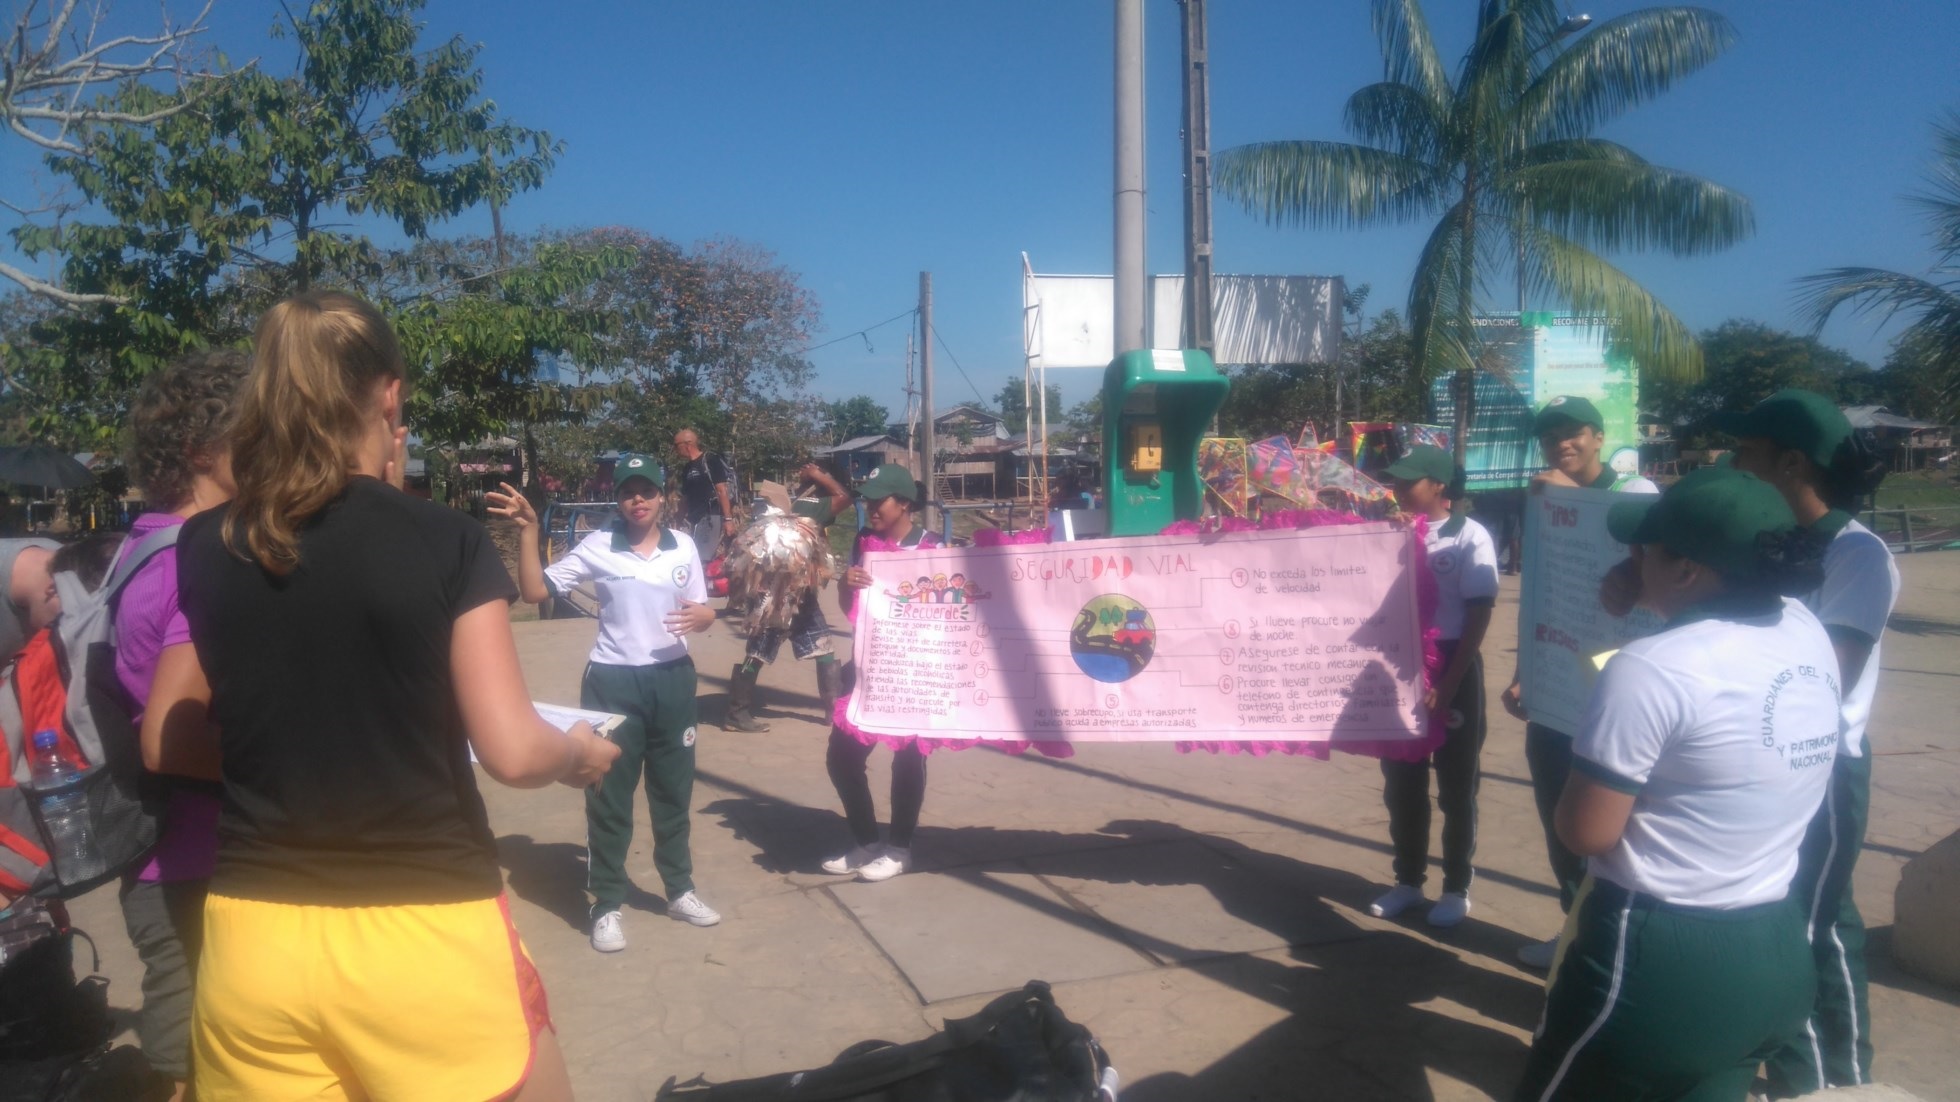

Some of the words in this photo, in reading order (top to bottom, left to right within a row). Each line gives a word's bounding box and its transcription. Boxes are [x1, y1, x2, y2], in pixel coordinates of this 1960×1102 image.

[1011, 555, 1134, 591] SEGURIDAD
[1147, 553, 1199, 576] VIAL
[1252, 569, 1266, 580] No
[1270, 568, 1307, 580] exceda
[1311, 566, 1326, 577] los
[1254, 582, 1269, 594] de
[1275, 582, 1321, 594] velocidad
[902, 603, 960, 620] Recuerde
[944, 624, 970, 633] estado
[1249, 616, 1258, 629] Si
[1265, 616, 1296, 627] llueve
[1301, 616, 1339, 628] procure
[1343, 616, 1356, 626] no
[871, 626, 881, 634] de
[886, 627, 897, 636] las
[1249, 630, 1262, 641] de
[1266, 630, 1294, 641] noche
[921, 638, 930, 646] de
[908, 646, 951, 655] documentos
[1238, 646, 1300, 662] Asegurese
[1305, 643, 1320, 655] de
[866, 666, 876, 674] de
[879, 666, 908, 676] bebidas
[916, 660, 932, 670] bajo
[934, 662, 942, 670] el
[865, 675, 894, 684] Atienda
[896, 676, 908, 686] las
[911, 678, 977, 690] recomendaciones
[1237, 676, 1276, 689] Procure
[1282, 677, 1312, 688] llevar
[1318, 674, 1358, 686] consigo
[865, 684, 874, 693] de
[878, 686, 889, 694] las
[891, 686, 938, 697] autoridades
[940, 690, 950, 698] de
[1286, 689, 1300, 700] de
[898, 696, 903, 704] y
[905, 696, 916, 704] no
[918, 698, 944, 706] circule
[949, 700, 960, 708] por
[1238, 701, 1284, 714] contenga
[1288, 698, 1346, 711] directorios
[1760, 668, 1794, 748] GUARDIANES
[1798, 664, 1820, 678] DEL
[898, 705, 948, 716] restringidas
[1034, 708, 1046, 717] No
[1128, 708, 1142, 717] usa
[1145, 706, 1197, 718] transporte
[1066, 717, 1090, 728] acuda
[1238, 714, 1246, 726] y
[1248, 714, 1287, 724] numeros
[1291, 713, 1304, 723] de
[1776, 744, 1786, 758] Y
[1790, 751, 1832, 770] NACIONAL
